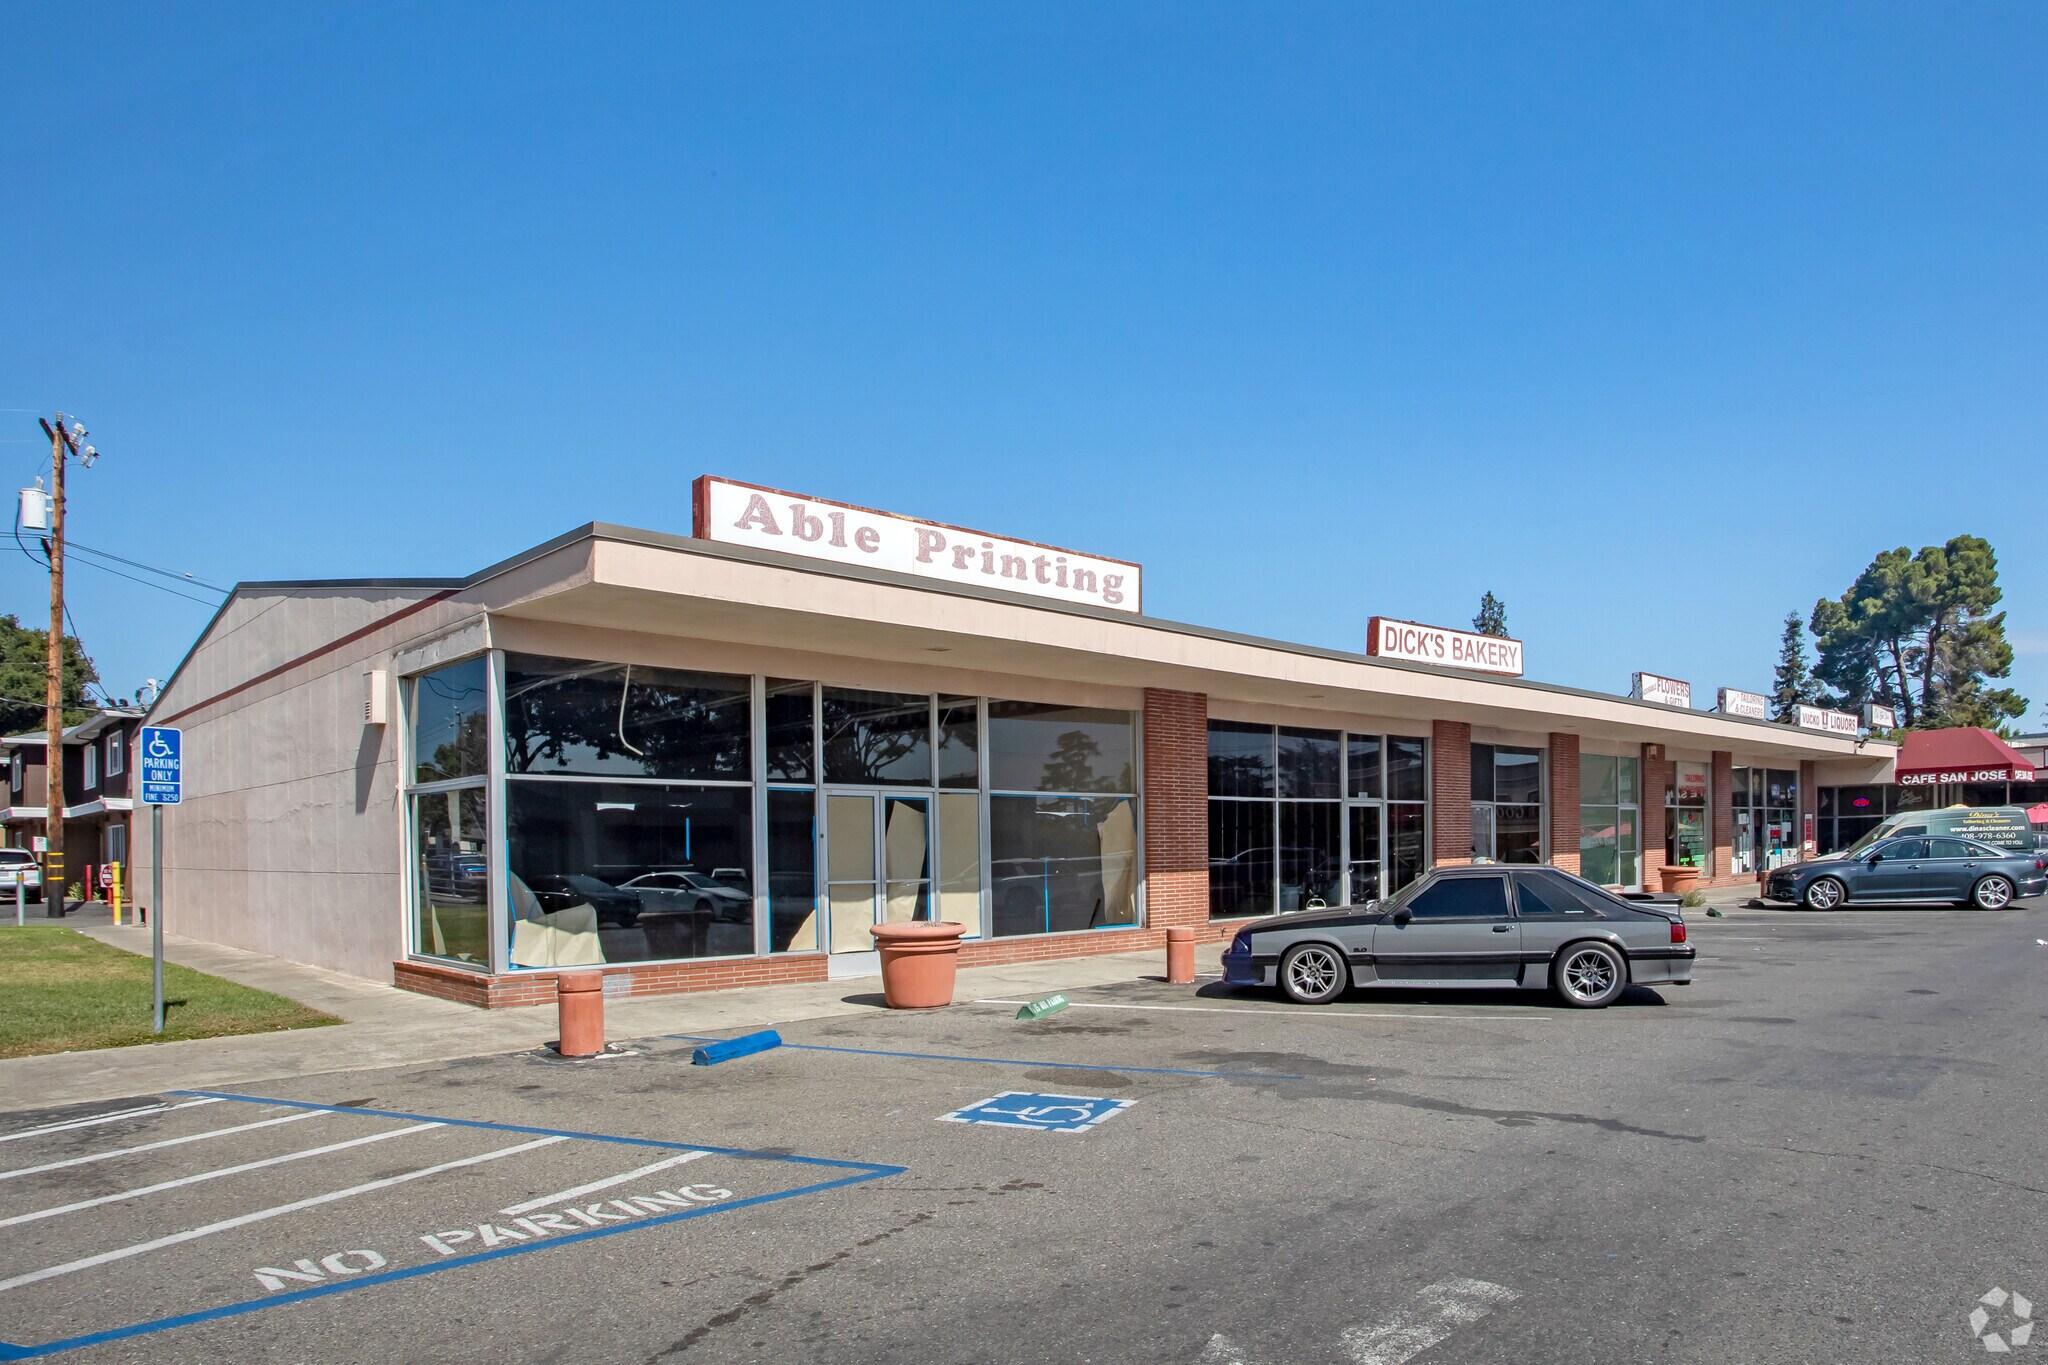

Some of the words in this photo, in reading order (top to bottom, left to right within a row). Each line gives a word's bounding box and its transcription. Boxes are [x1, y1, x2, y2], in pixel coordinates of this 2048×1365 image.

[733, 493, 881, 554] Able
[913, 526, 1125, 605] Printing
[1384, 625, 1446, 659] DICK'S
[1452, 636, 1518, 669] BAKERY
[1656, 678, 1690, 699] FLOWERS
[1669, 695, 1684, 707] GIFTS
[1740, 691, 1764, 706] TAILORING
[1740, 703, 1764, 717] CLEANERS
[1830, 715, 1857, 733] LIQUORS
[143, 757, 180, 770] PARKING
[150, 769, 173, 781] ONLY
[1901, 773, 1937, 785] CAFE
[1940, 772, 1968, 783] SAN
[1970, 769, 2008, 781] JOSE
[149, 784, 175, 793] MINIMUM
[145, 792, 158, 801] FINE
[1950, 824, 2026, 832] www.dinascleaner.com
[252, 1248, 389, 1292] NO
[418, 1183, 734, 1256] PARKING
